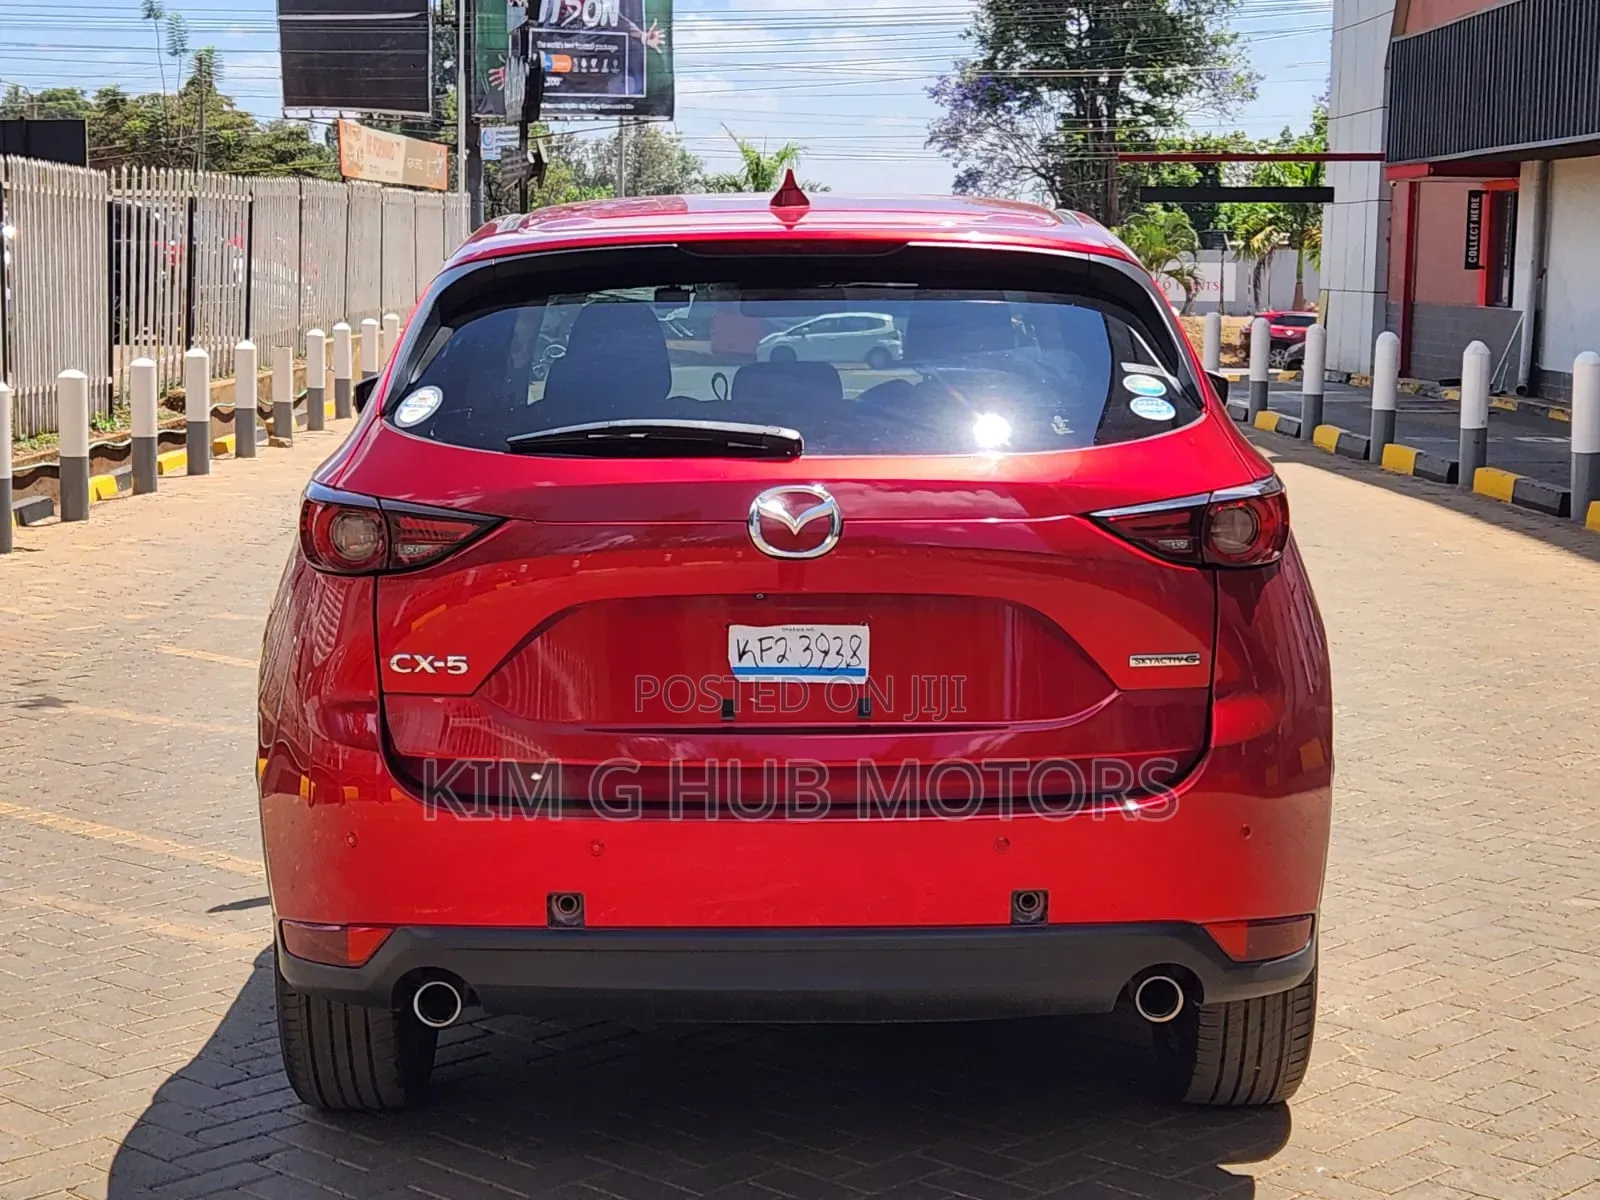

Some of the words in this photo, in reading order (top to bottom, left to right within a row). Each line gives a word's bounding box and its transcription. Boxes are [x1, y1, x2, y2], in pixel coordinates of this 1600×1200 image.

[1469, 196, 1480, 221] HERE
[1468, 223, 1480, 263] COLLECT
[389, 653, 469, 675] CX-5
